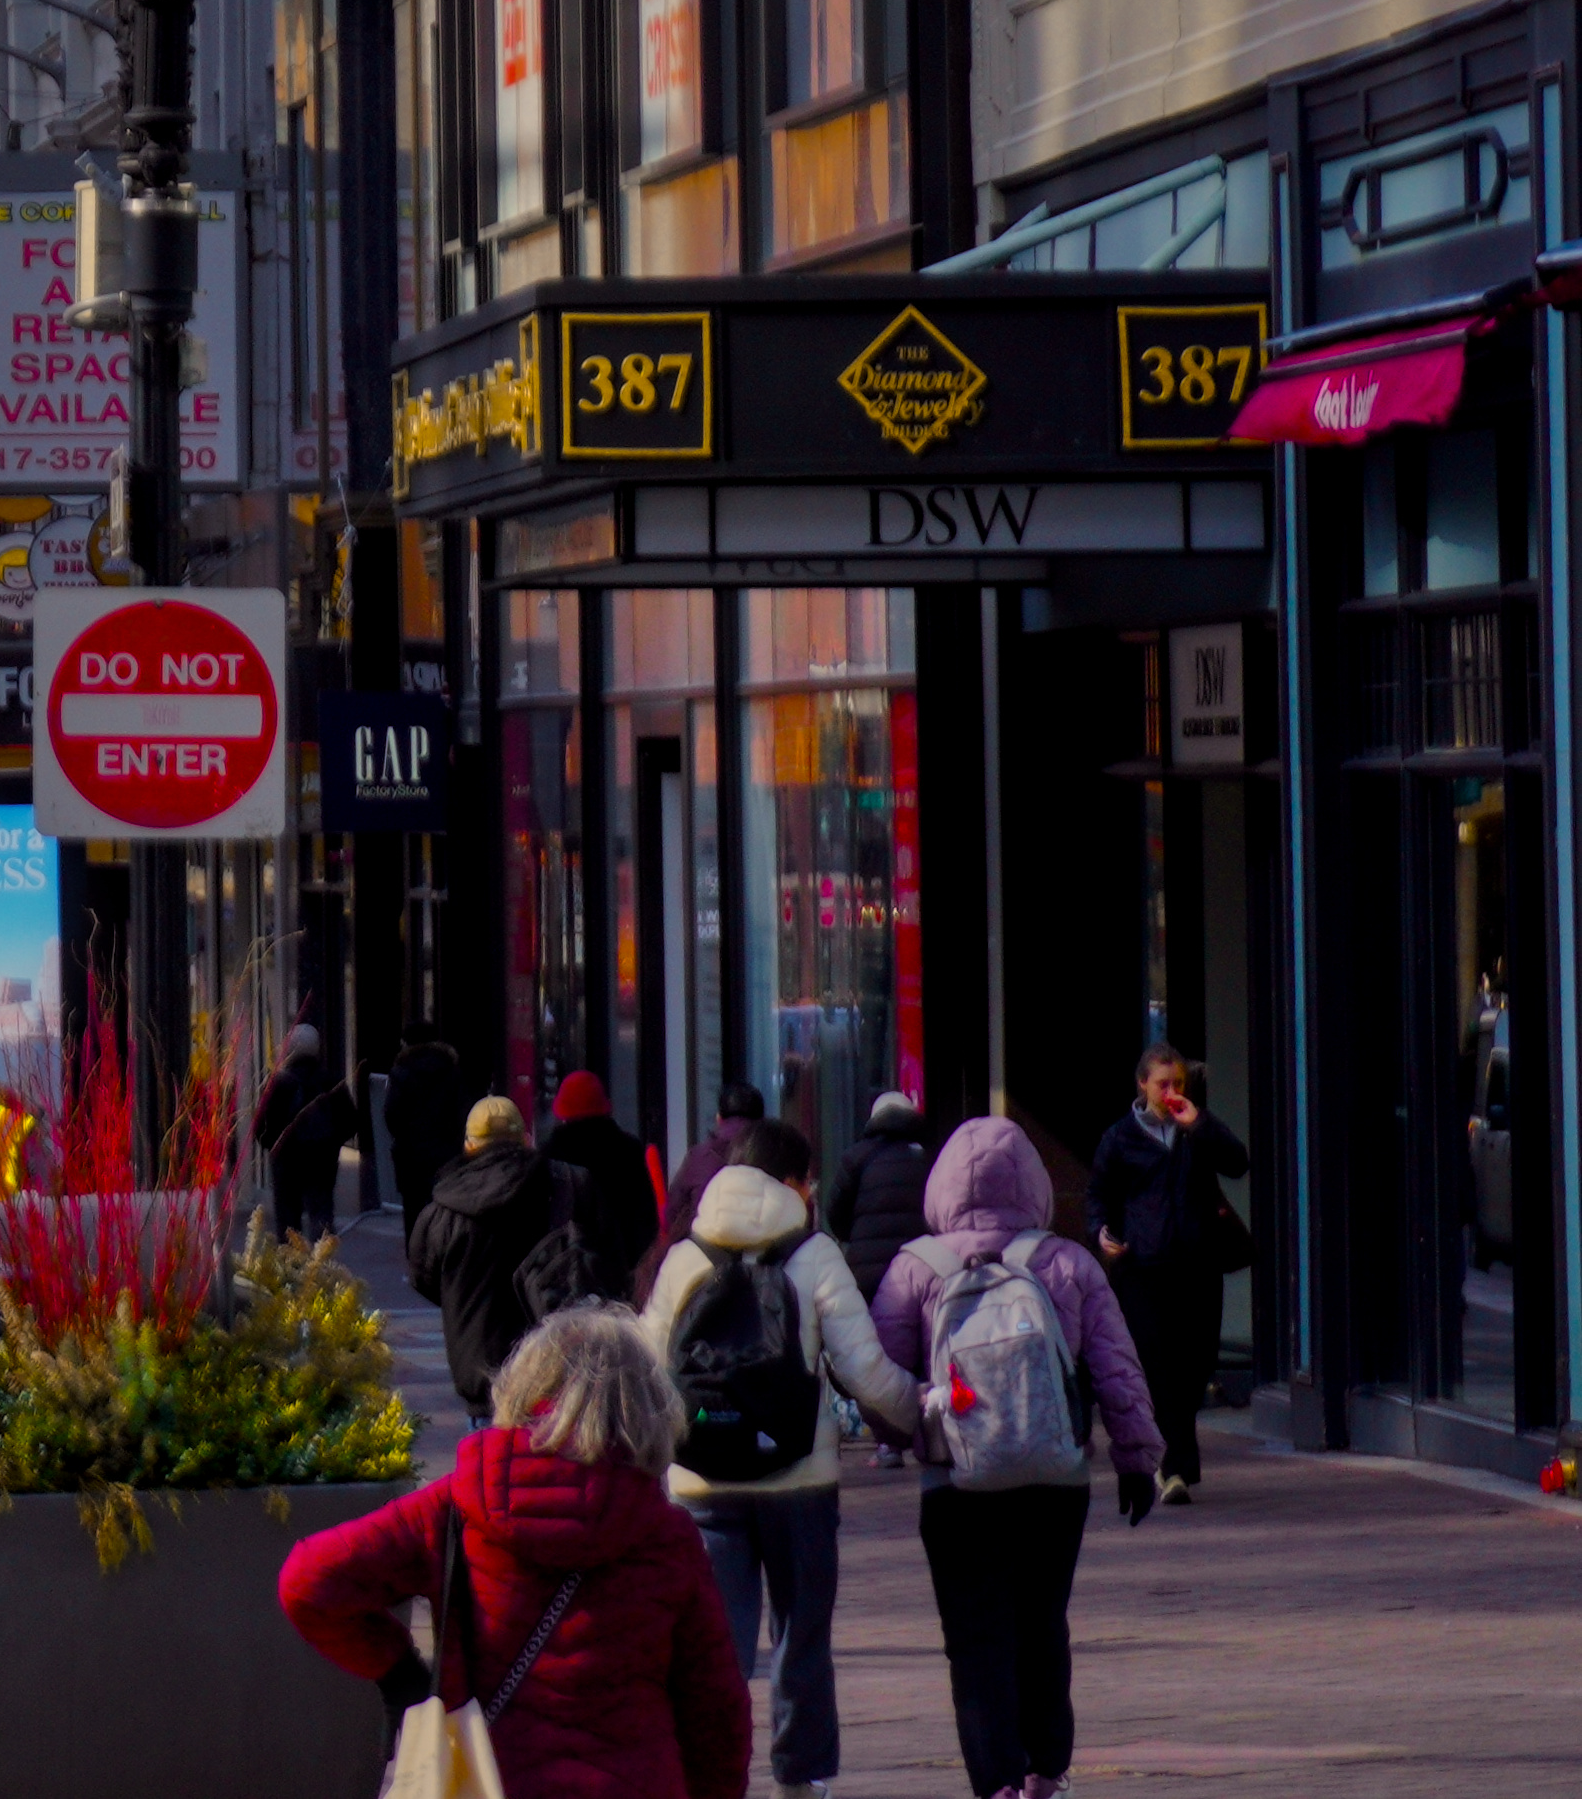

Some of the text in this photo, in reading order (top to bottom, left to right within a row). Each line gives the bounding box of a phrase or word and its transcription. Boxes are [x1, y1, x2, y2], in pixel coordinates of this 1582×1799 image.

[20, 202, 76, 221] COR
[11, 353, 130, 384] SPAC
[896, 345, 929, 360] THE
[577, 353, 694, 414] 387
[851, 362, 971, 390] Diamond
[1139, 345, 1255, 405] 387
[881, 424, 950, 439] BUILDING
[866, 485, 1041, 548] DSW
[80, 652, 244, 687] DO NOT
[97, 744, 227, 778] ENTER
[355, 725, 430, 782] GAP
